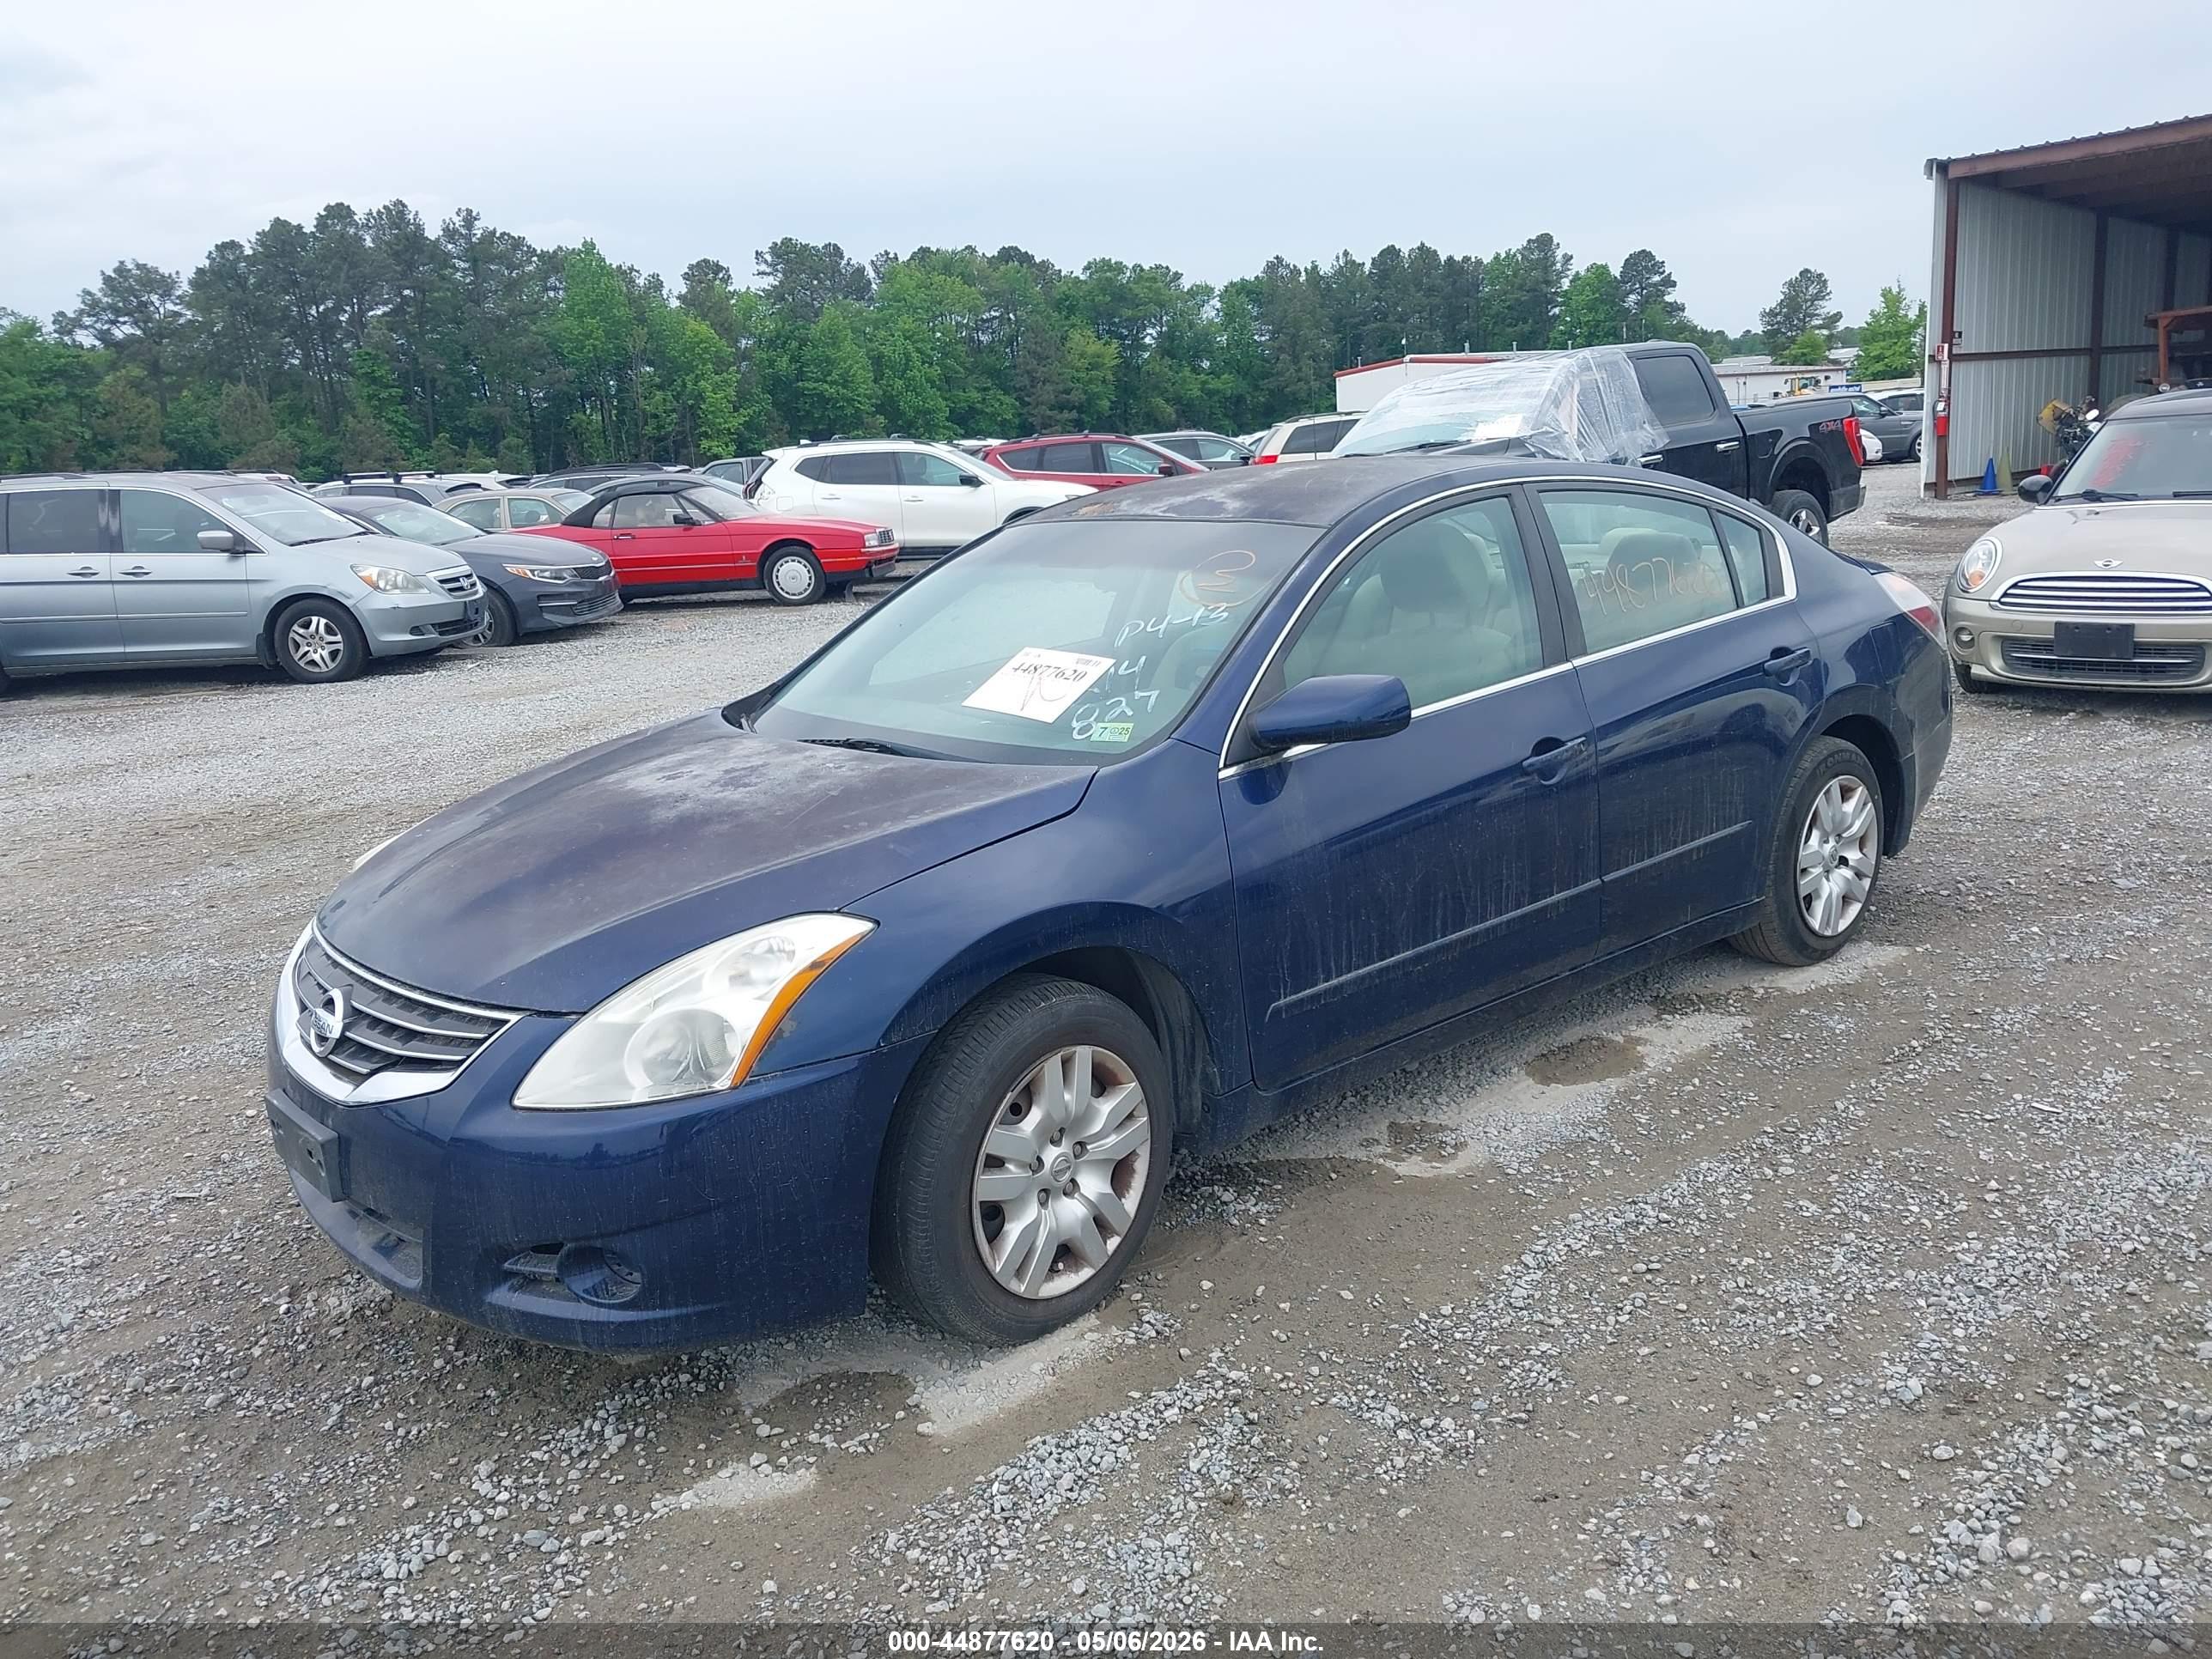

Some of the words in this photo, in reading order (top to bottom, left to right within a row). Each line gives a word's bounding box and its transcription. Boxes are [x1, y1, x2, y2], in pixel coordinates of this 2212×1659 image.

[1012, 662, 1088, 682] 44877620
[1099, 726, 1109, 737] 7
[1119, 726, 1131, 736] 25
